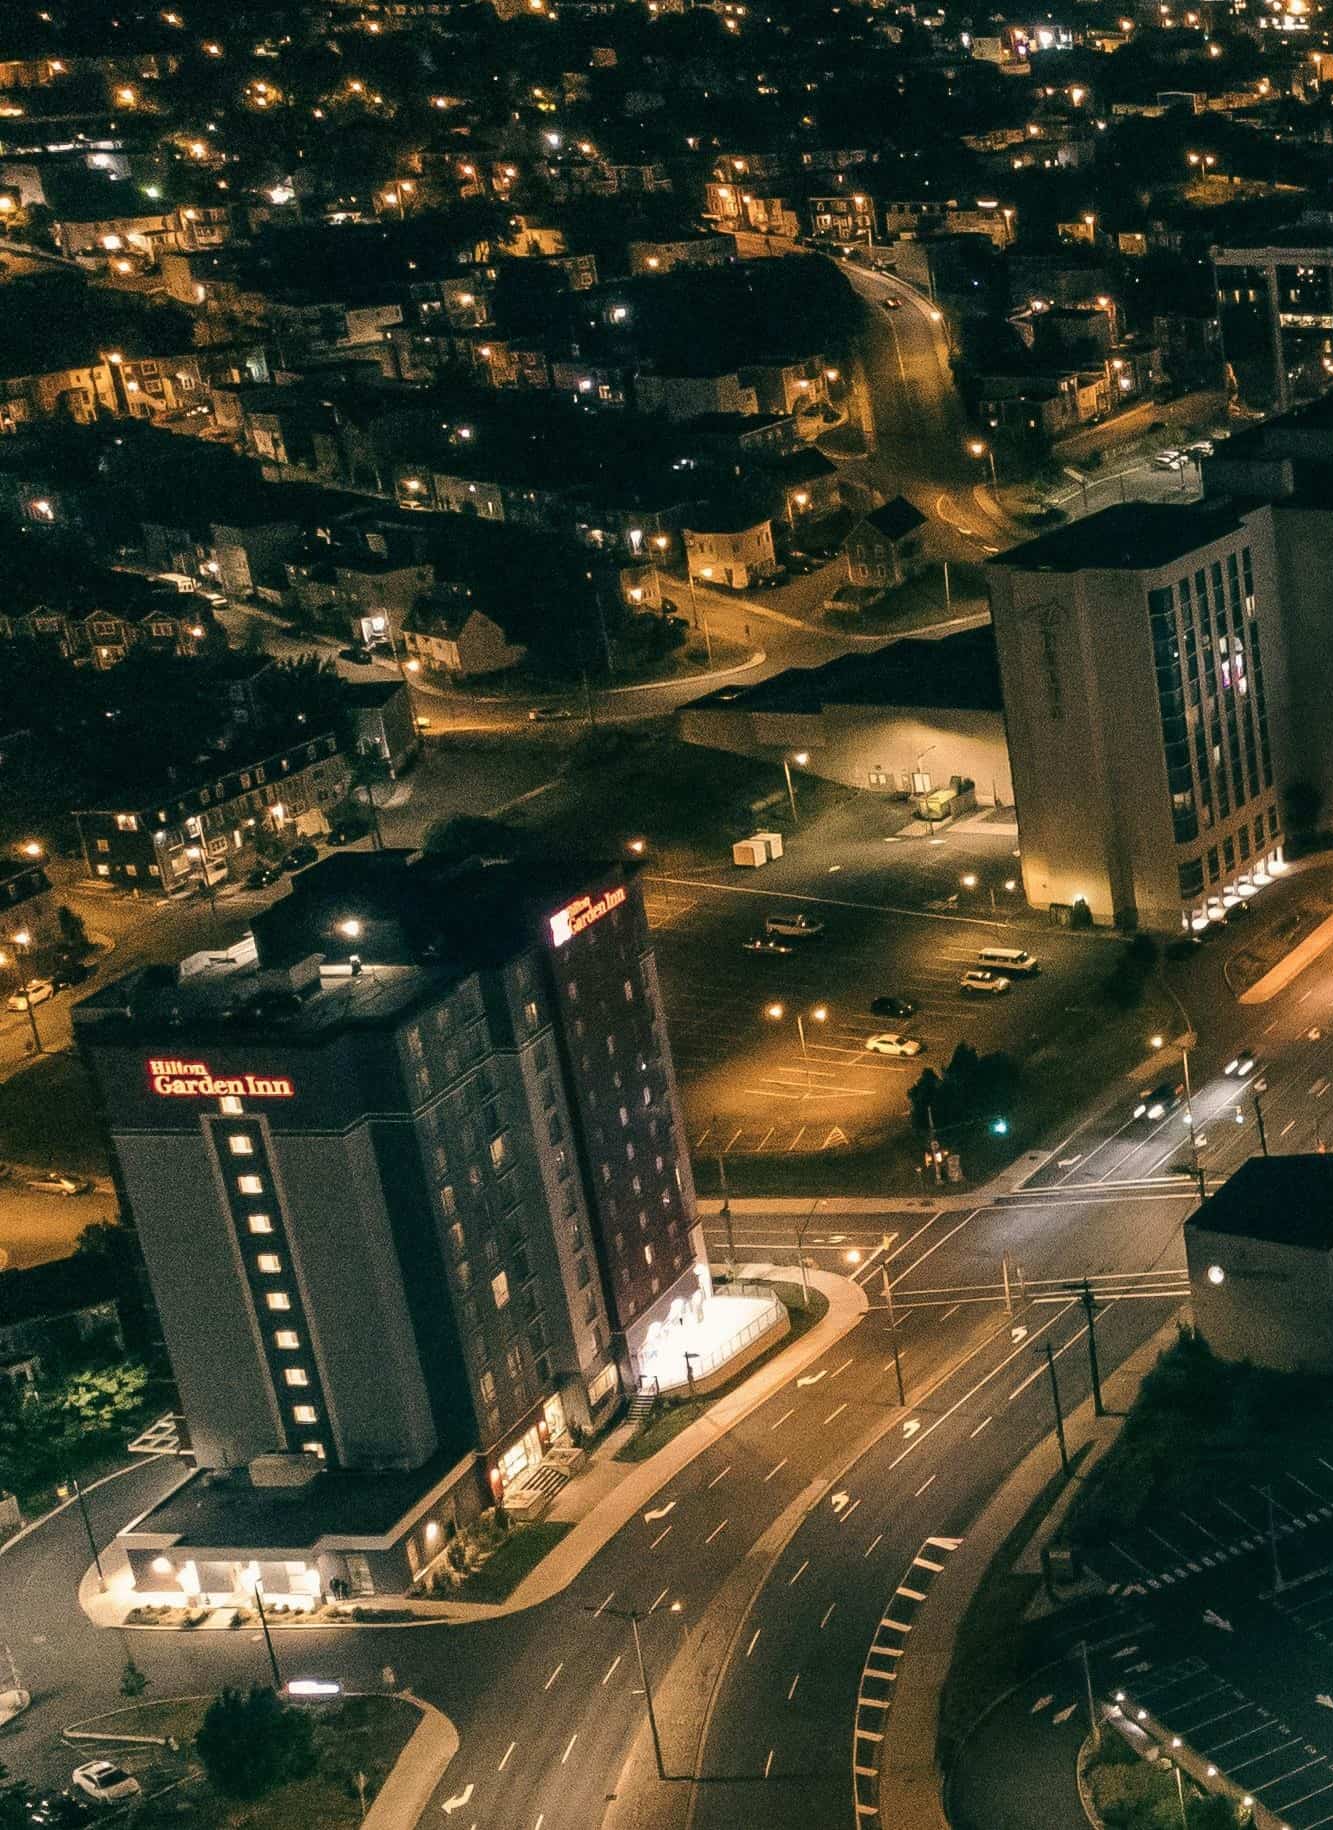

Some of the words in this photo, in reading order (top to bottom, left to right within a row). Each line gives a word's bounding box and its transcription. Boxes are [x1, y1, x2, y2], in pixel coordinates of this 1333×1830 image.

[605, 888, 627, 911] Inn
[149, 1060, 208, 1076] Hilton
[155, 1076, 247, 1096] Garden
[245, 1076, 294, 1096] Inn
